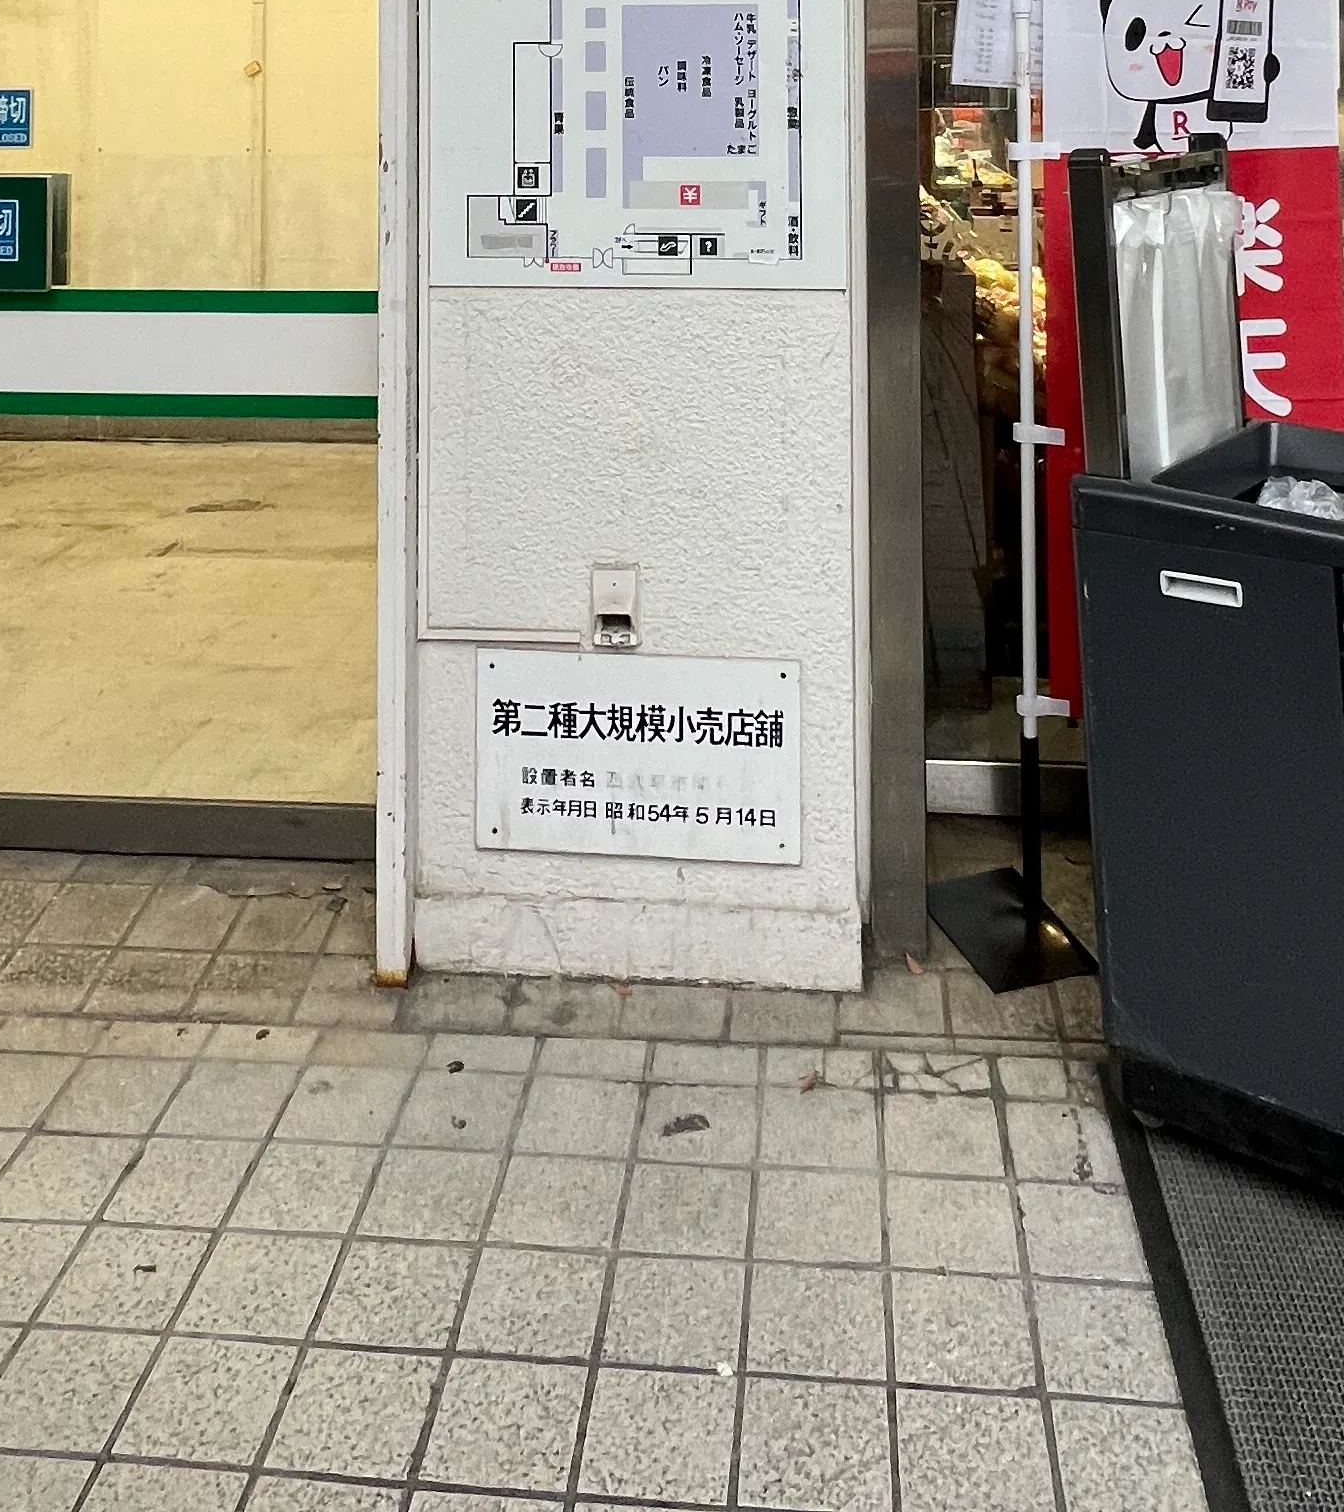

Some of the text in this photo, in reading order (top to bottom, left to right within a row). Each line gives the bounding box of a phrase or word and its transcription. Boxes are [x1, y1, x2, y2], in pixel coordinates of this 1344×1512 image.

[658, 65, 669, 87] パン
[491, 698, 784, 749] 第二種大規模小売店舗
[521, 767, 596, 788] 設置者名
[520, 797, 598, 819] 表示年月日
